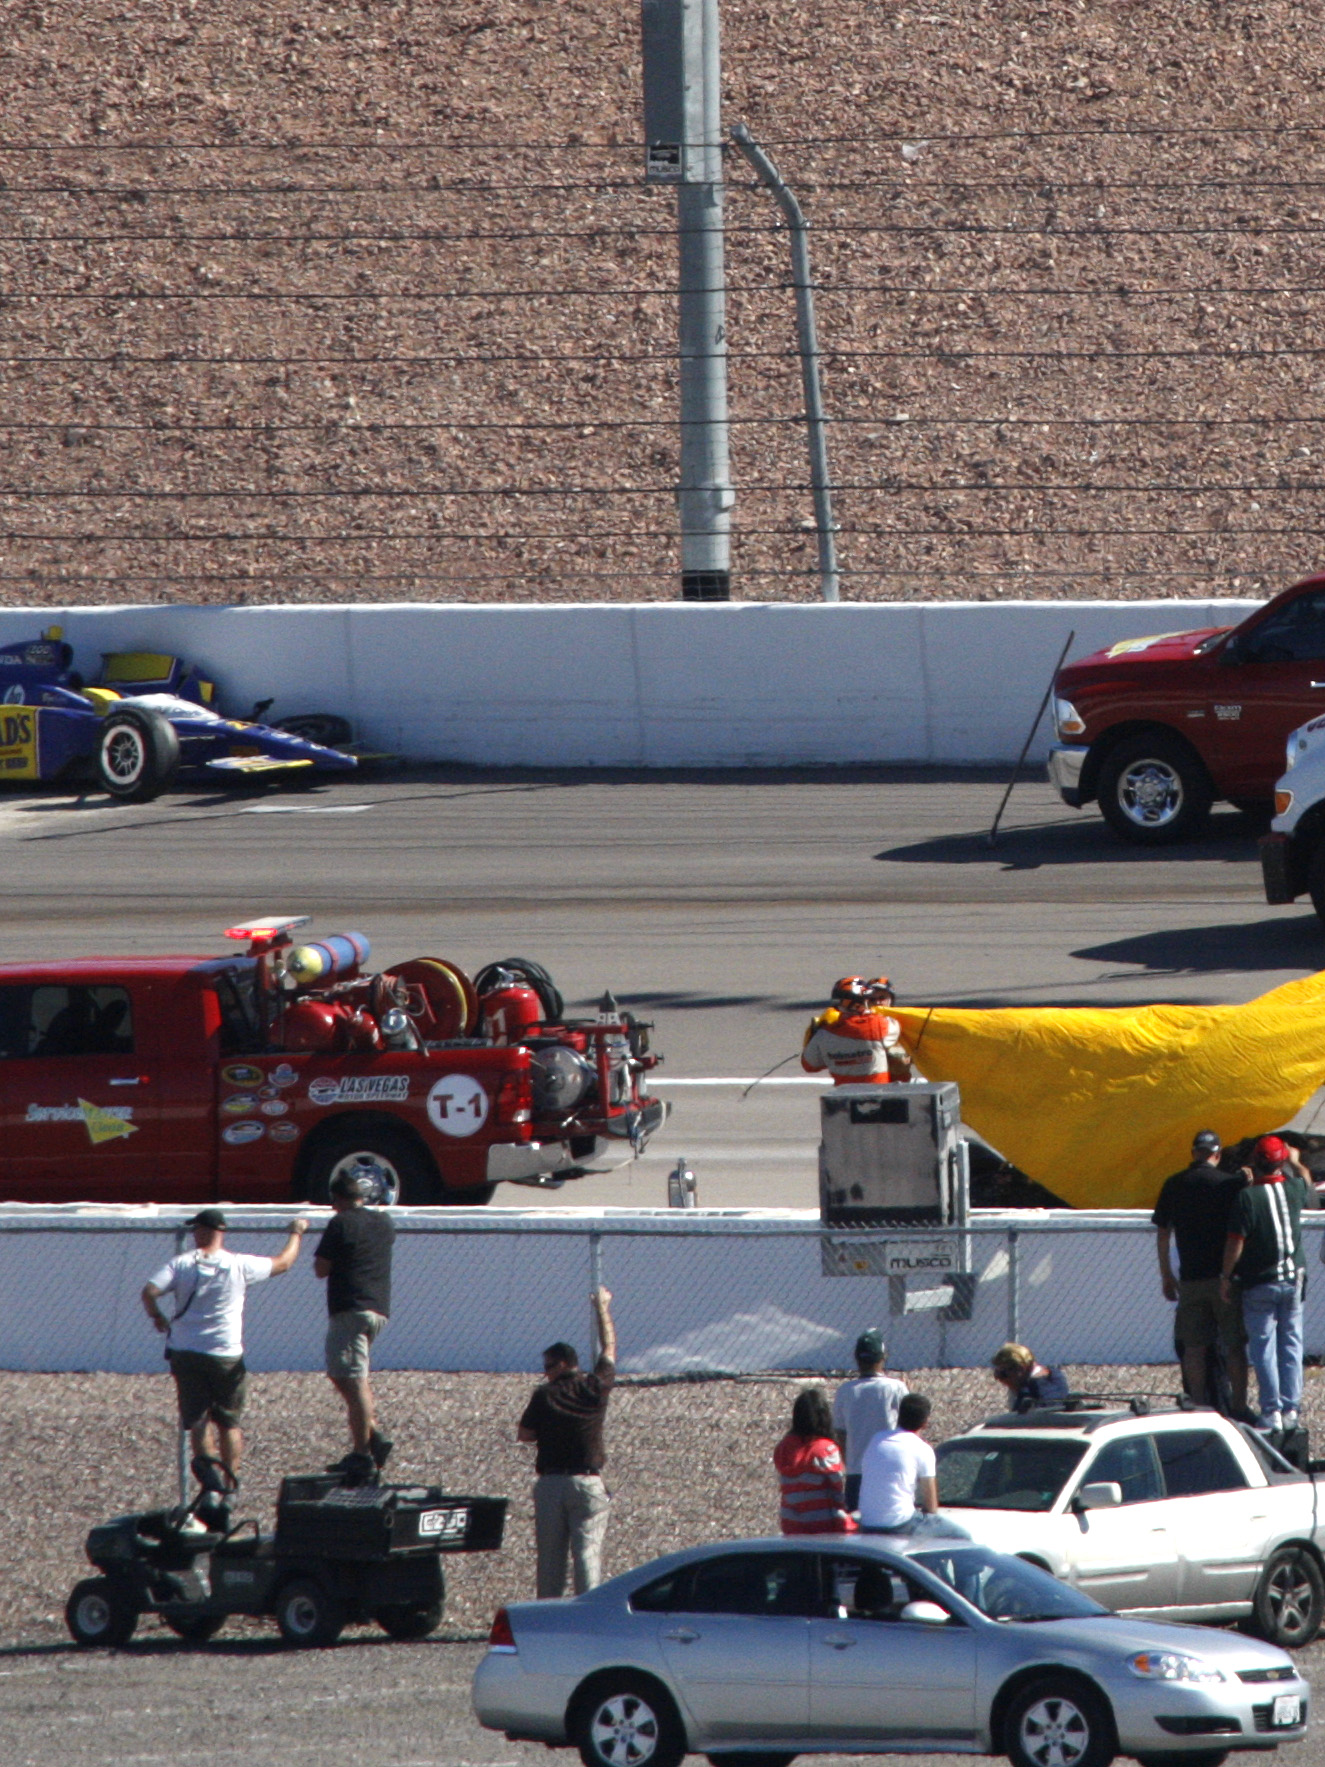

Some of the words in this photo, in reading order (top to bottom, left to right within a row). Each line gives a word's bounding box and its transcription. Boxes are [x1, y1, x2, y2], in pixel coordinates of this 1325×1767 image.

[340, 1078, 366, 1093] LAS
[367, 1077, 408, 1092] VEGAS
[433, 1093, 482, 1119] T-1
[890, 1257, 952, 1269] musco
